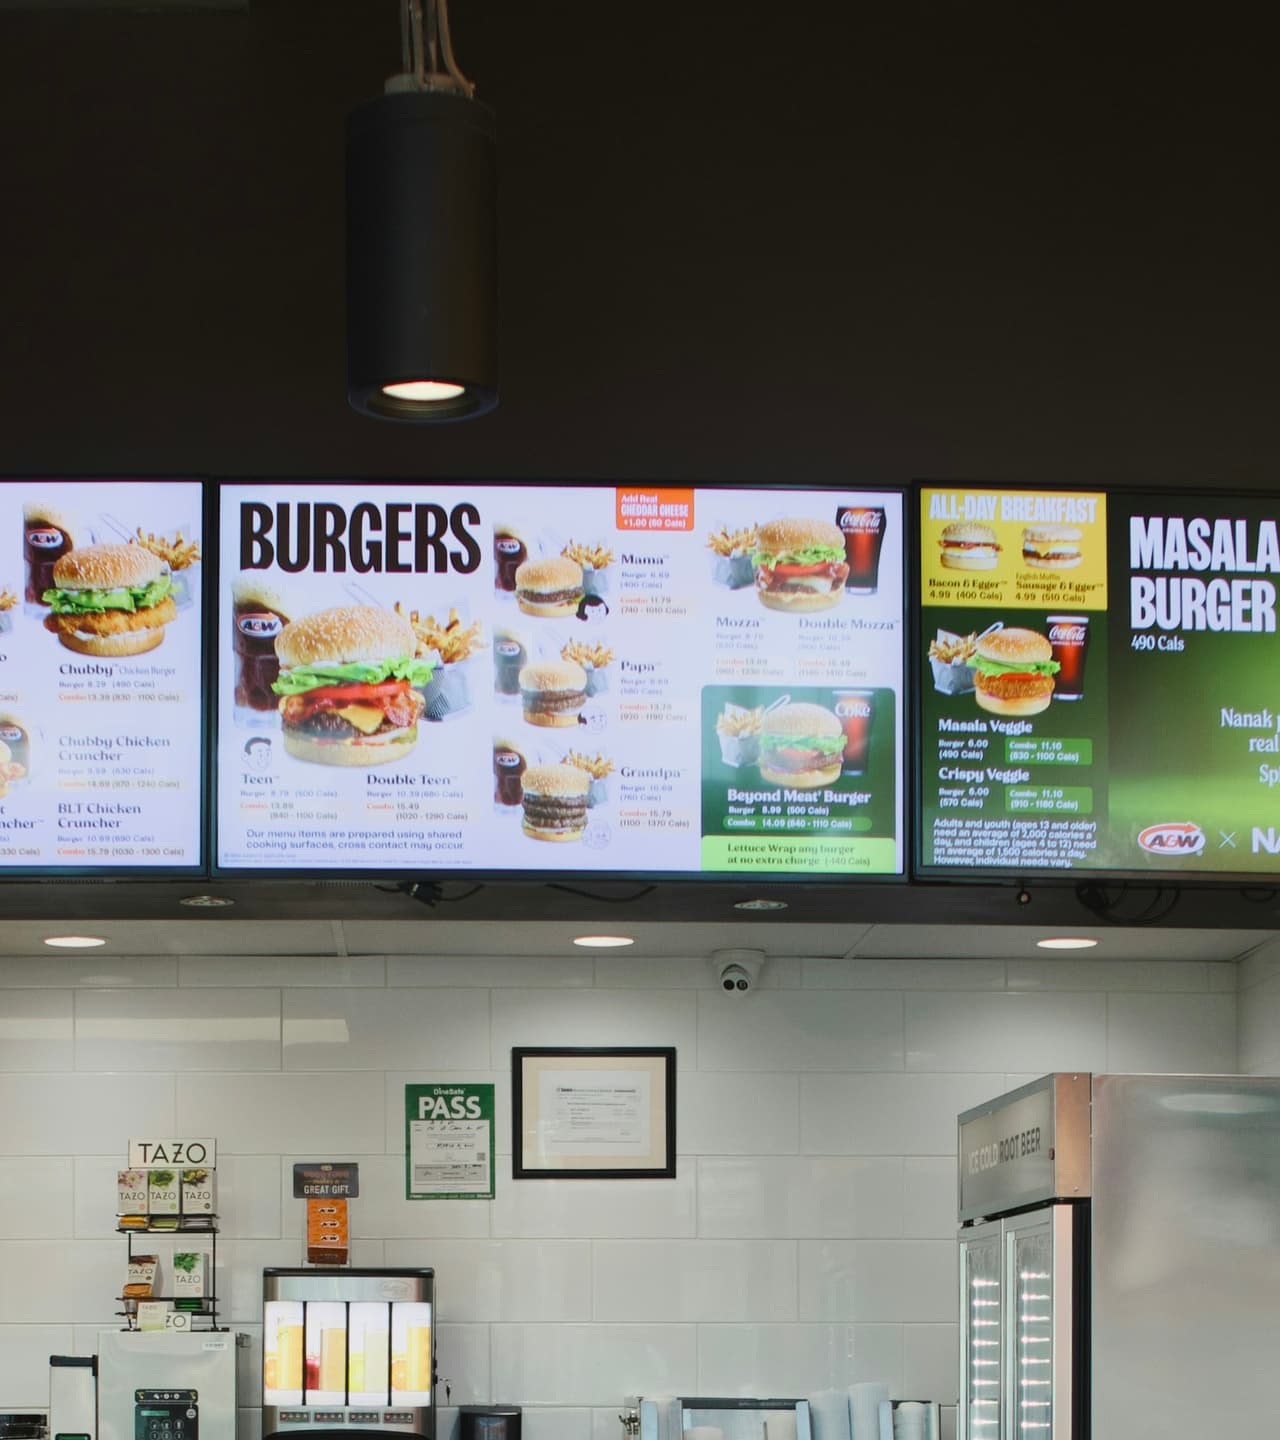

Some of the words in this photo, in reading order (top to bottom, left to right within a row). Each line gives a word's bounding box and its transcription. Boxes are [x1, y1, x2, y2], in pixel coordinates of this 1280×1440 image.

[929, 494, 997, 521] ALL-DAY
[1001, 496, 1097, 524] BREAKFAST
[240, 501, 481, 574] BURGERS
[1130, 516, 1280, 573] MASALA
[929, 579, 960, 587] Bacon
[1016, 582, 1056, 590] Sausage
[980, 592, 1002, 601] Cals)
[1130, 576, 1276, 632] BURGER
[1131, 635, 1154, 651] 490
[1158, 636, 1185, 652] Cals
[1220, 709, 1272, 728] Nanak
[939, 719, 987, 732] Masala
[990, 720, 1033, 735] Veggie
[968, 740, 988, 748] 6.00
[1249, 734, 1279, 753] real
[961, 751, 983, 760] Cals)
[939, 767, 983, 782] Crispy
[987, 768, 1030, 783] Veggie
[728, 789, 780, 804] Beyond
[825, 790, 871, 806] Burger
[58, 803, 84, 814] BLT
[87, 803, 141, 814] Chicken
[58, 818, 122, 829] Cruncher
[934, 819, 963, 827] Adults
[965, 820, 982, 828] and
[985, 820, 1010, 830] youth
[1040, 821, 1049, 829] 13
[1052, 821, 1067, 830] and
[247, 829, 264, 839] Our
[268, 830, 295, 839] menu
[298, 829, 326, 839] items
[329, 831, 345, 839] are
[348, 830, 394, 841] prepared
[397, 830, 424, 841] using
[427, 830, 462, 839] shared
[1149, 833, 1200, 847] A&W
[419, 1096, 481, 1119] PASS
[1000, 1135, 1019, 1163] ROOT
[1021, 1127, 1040, 1156] BEER
[138, 1143, 207, 1163] TAZO
[120, 1192, 145, 1200] TAZO
[150, 1192, 176, 1200] TAZO
[185, 1191, 210, 1199] TAZO
[304, 1185, 329, 1194] GREAT
